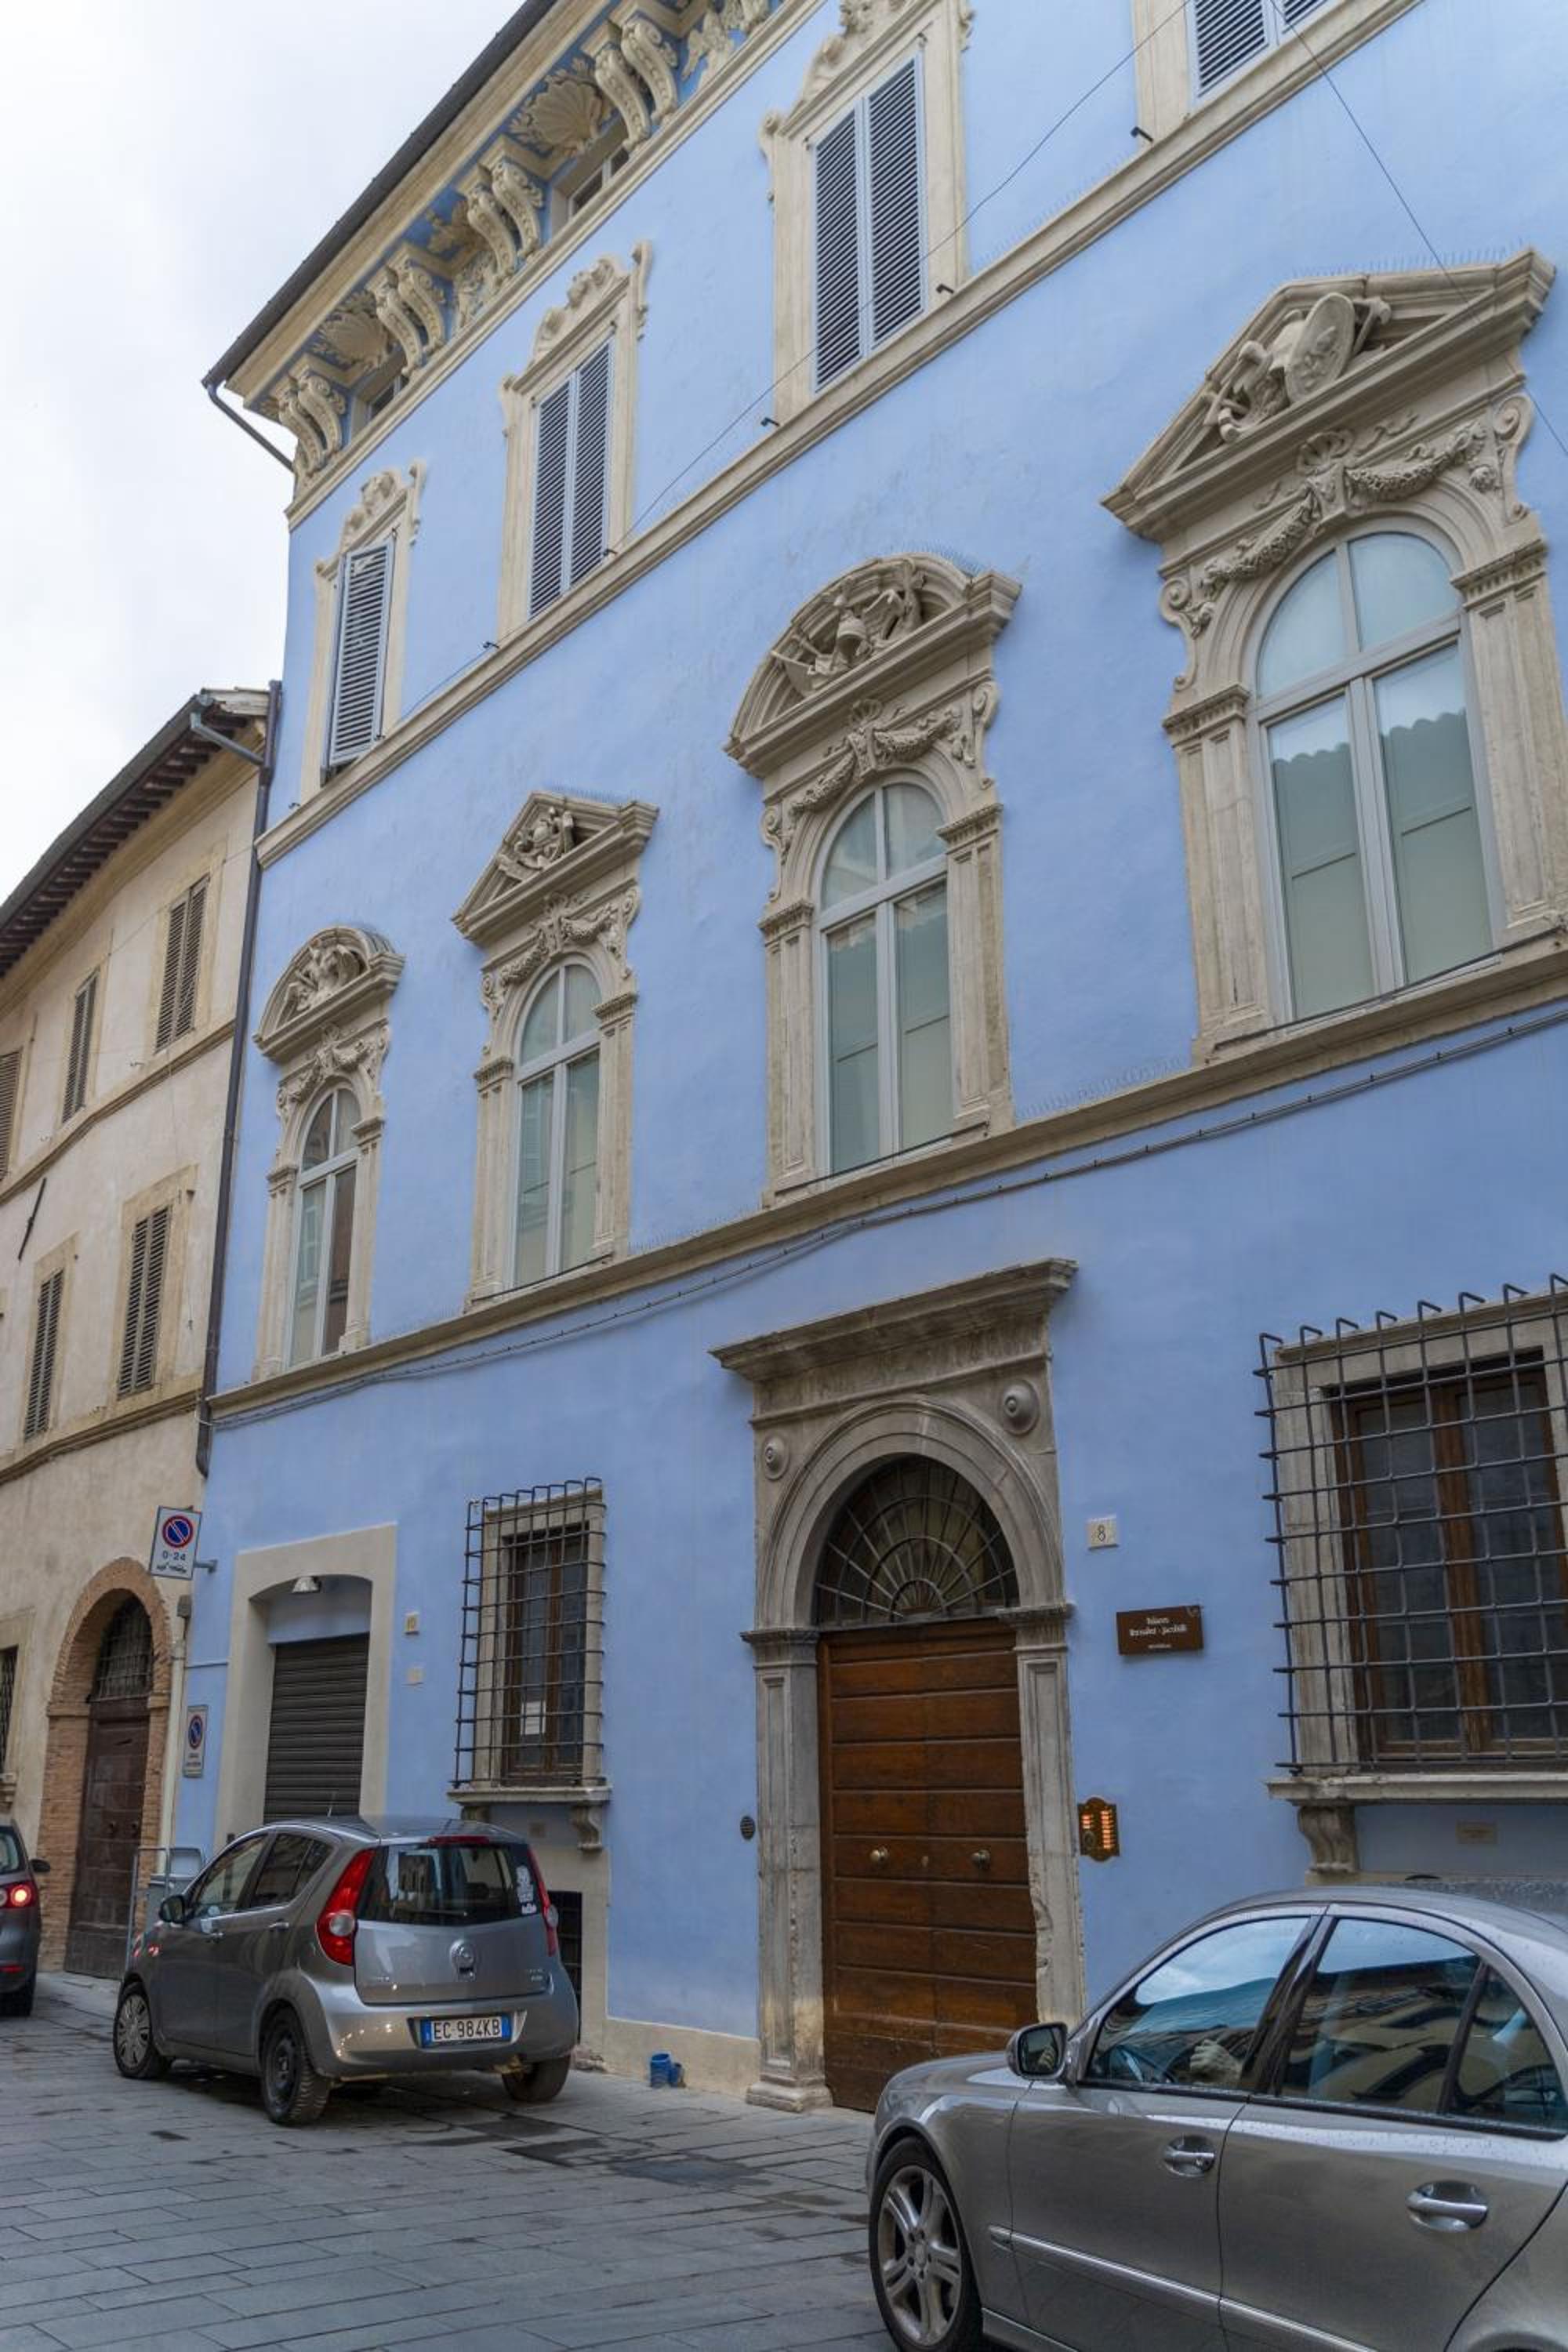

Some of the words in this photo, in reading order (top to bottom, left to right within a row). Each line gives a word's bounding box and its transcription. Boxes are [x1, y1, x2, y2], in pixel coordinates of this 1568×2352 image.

[1098, 1524, 1106, 1542] 8
[434, 2022, 452, 2040] EC
[457, 2019, 501, 2038] 984KB
